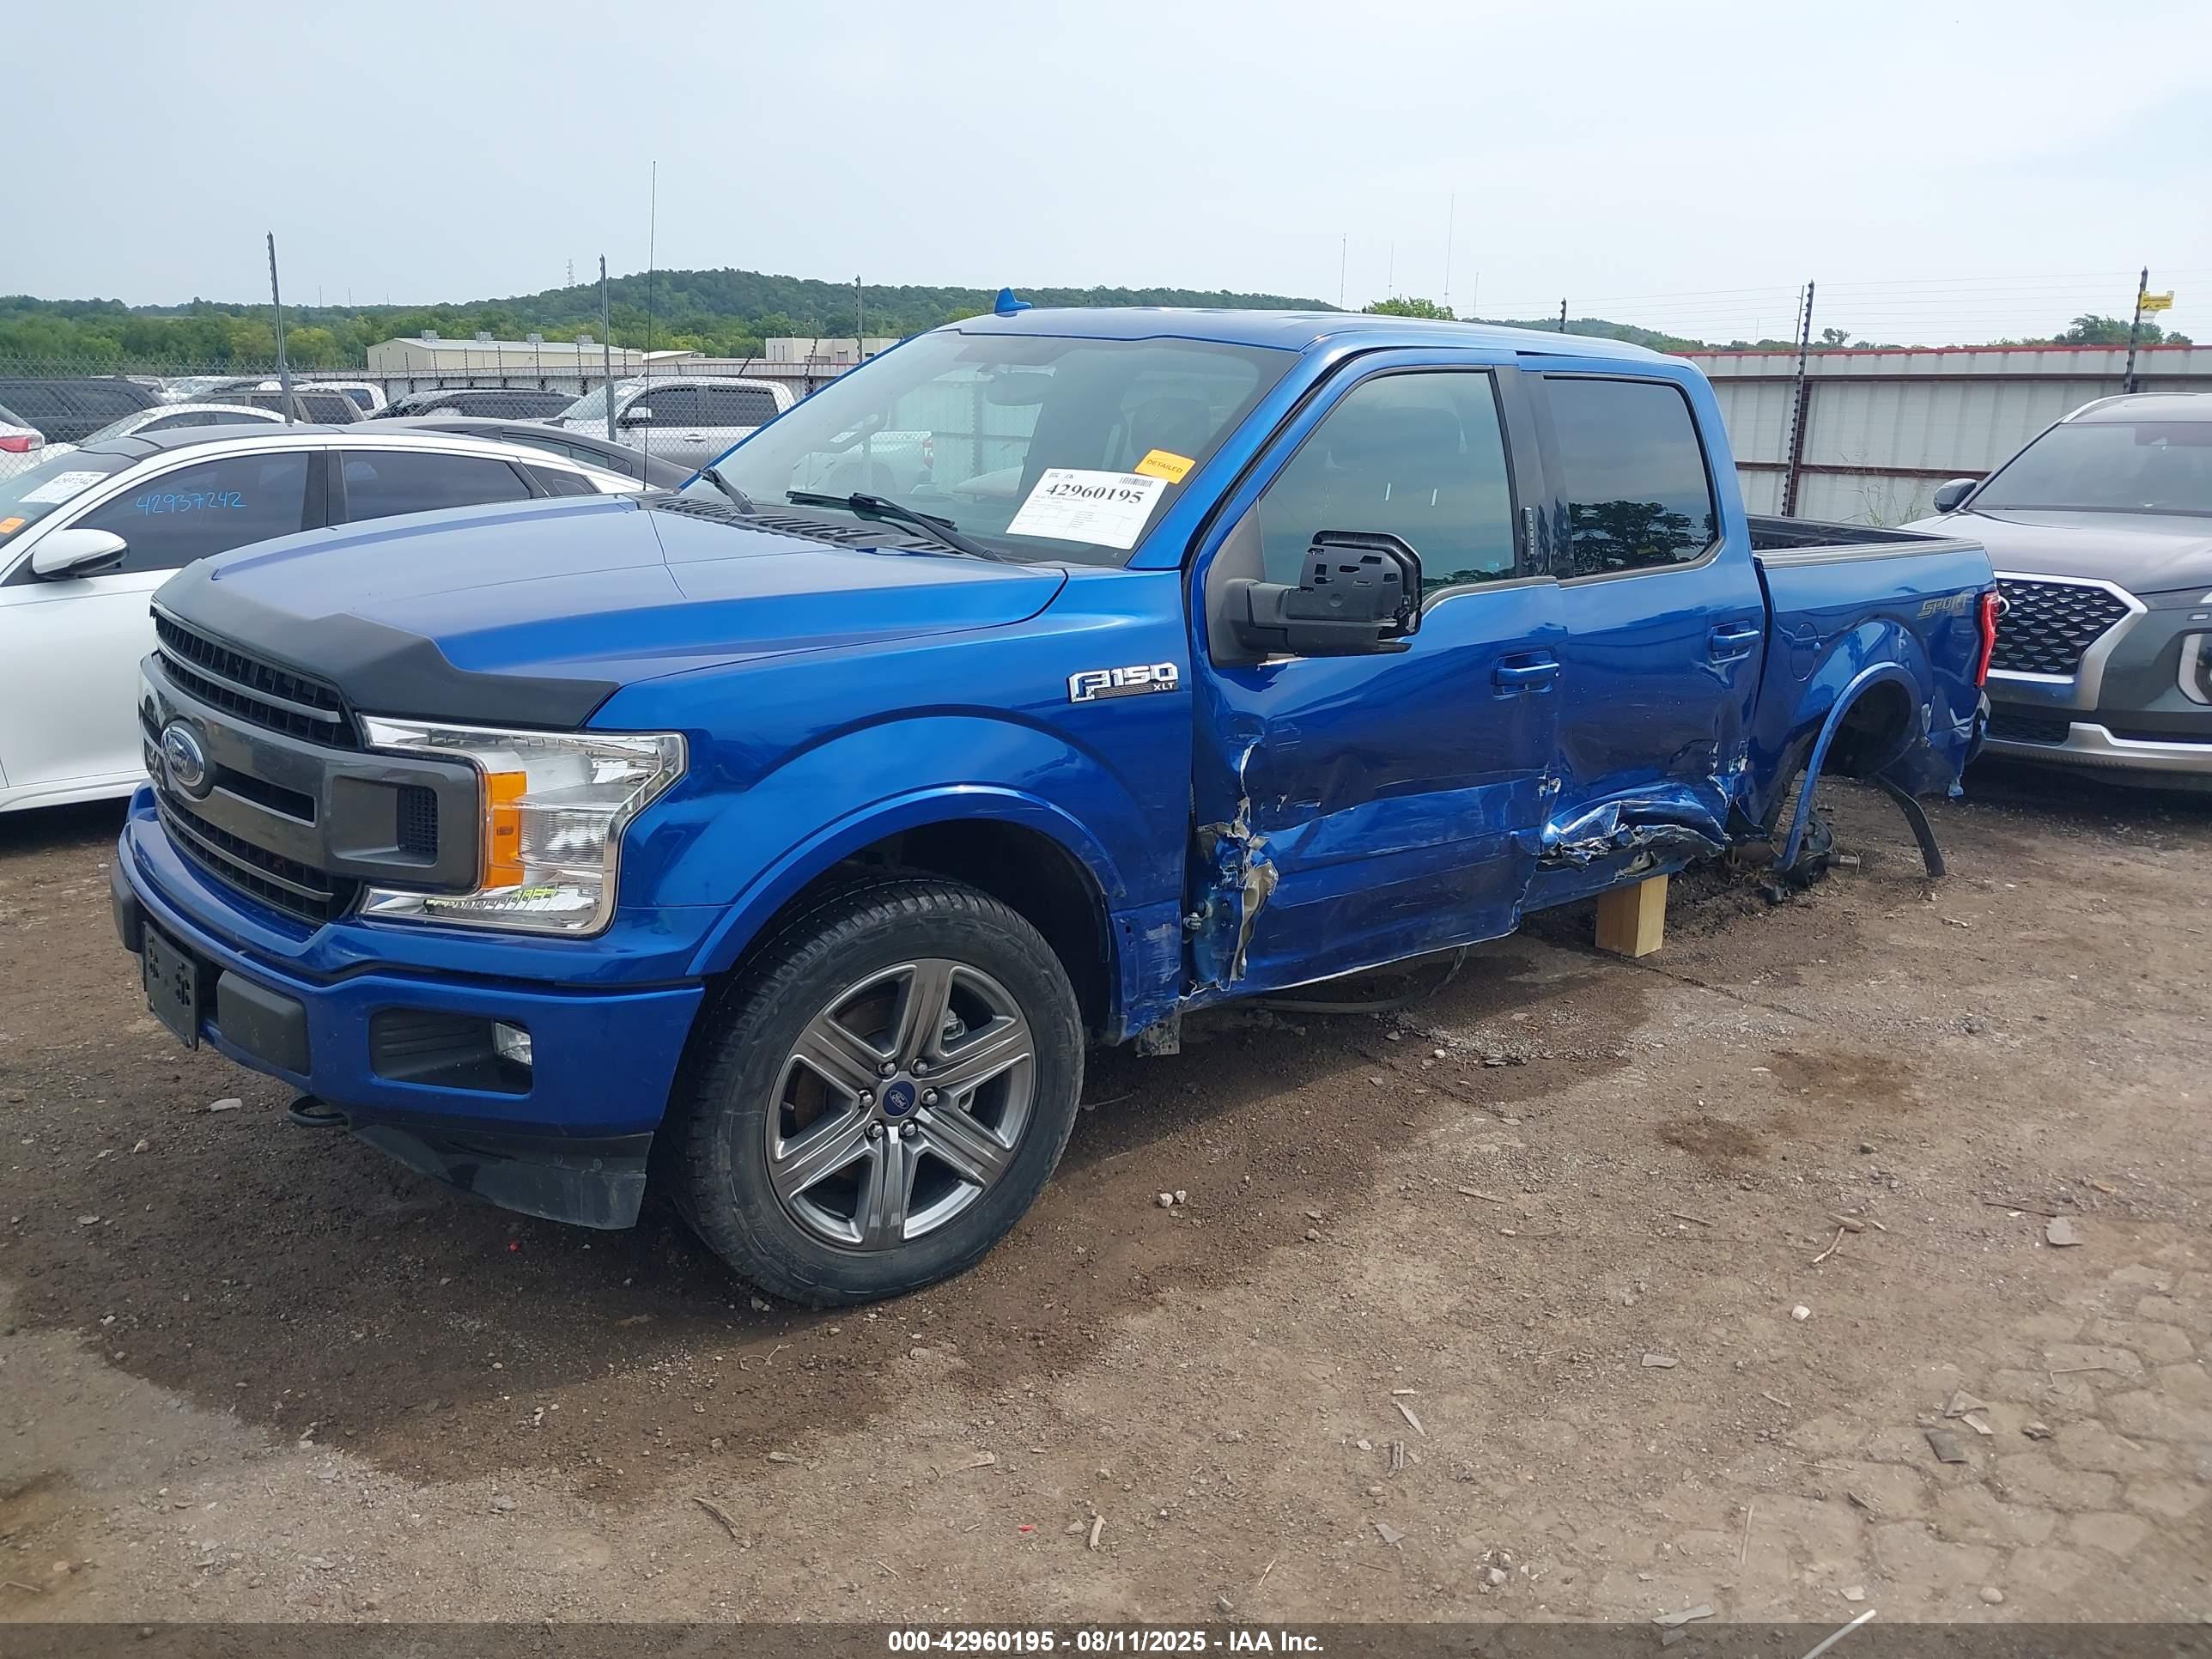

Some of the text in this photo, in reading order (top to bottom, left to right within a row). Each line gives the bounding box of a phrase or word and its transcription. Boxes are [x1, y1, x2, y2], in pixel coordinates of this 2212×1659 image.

[1146, 459, 1183, 474] DETAILED
[1046, 483, 1145, 504] 42960195
[136, 491, 247, 515] 42937242
[1153, 682, 1176, 691] XLT
